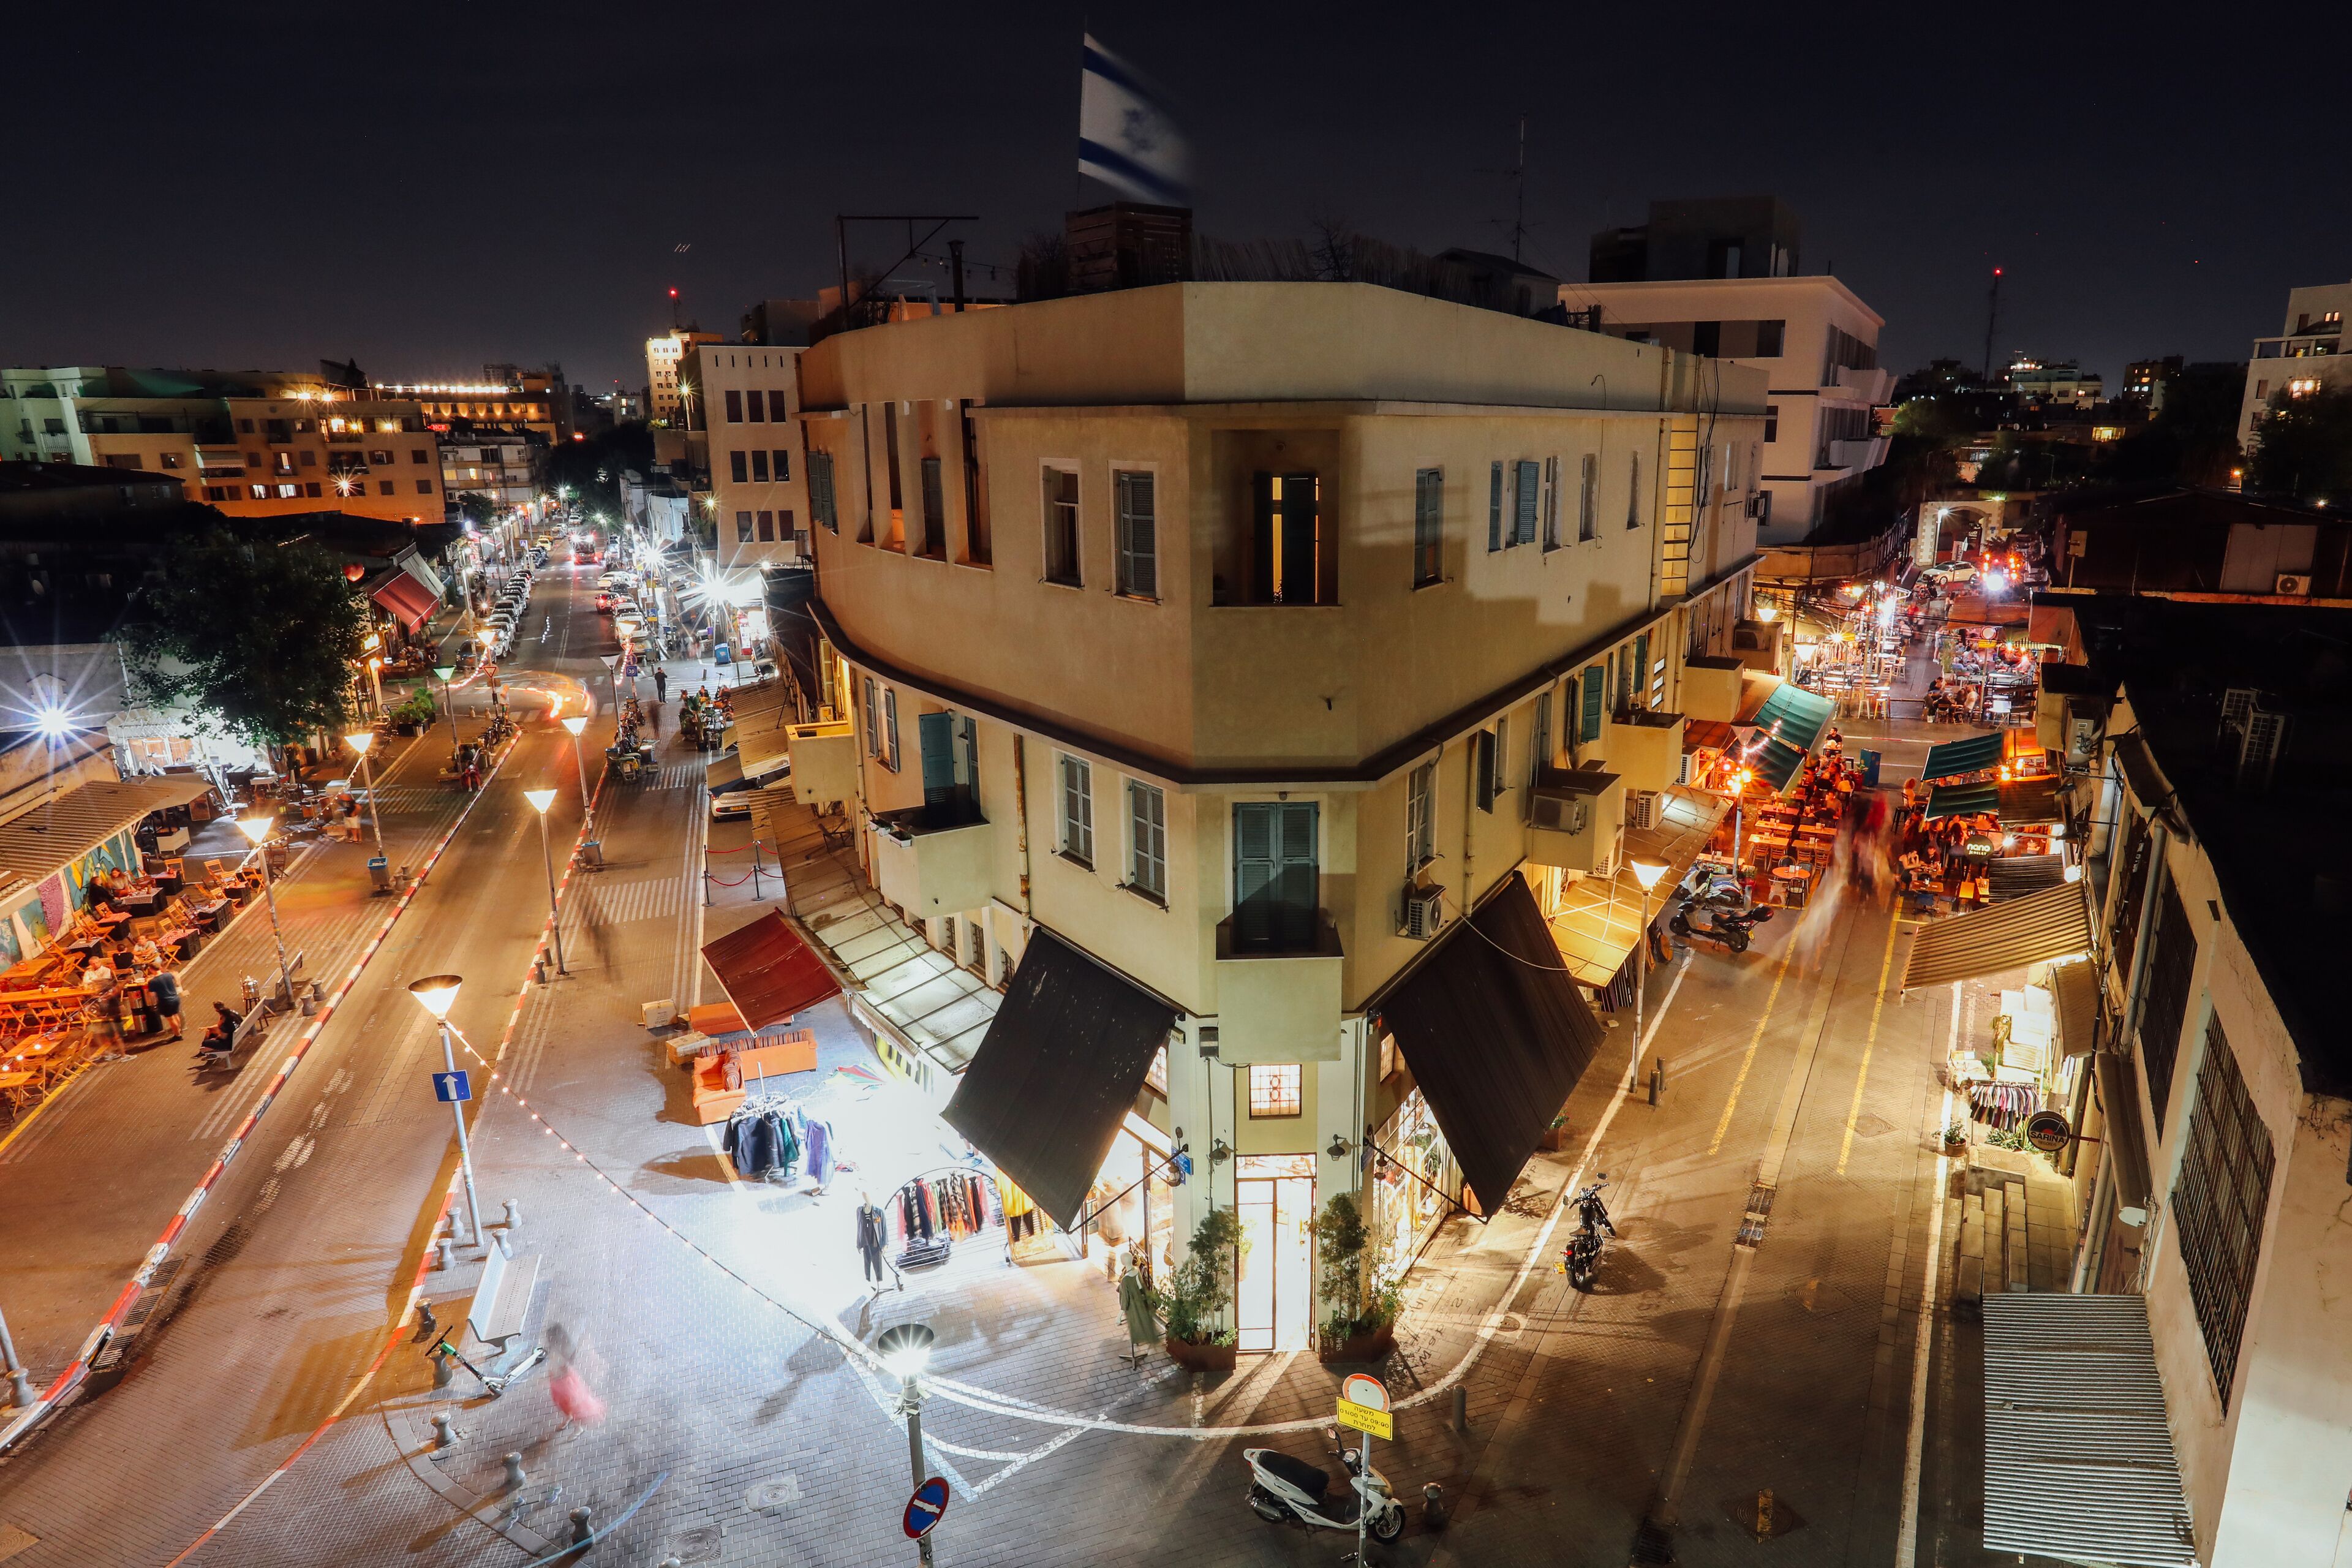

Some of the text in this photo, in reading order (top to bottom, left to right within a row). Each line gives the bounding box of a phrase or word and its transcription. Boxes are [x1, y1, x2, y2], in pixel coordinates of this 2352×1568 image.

[1967, 843, 1991, 852] nano
[2030, 1131, 2065, 1144] SARINA
[1353, 1406, 1374, 1417] משעה
[1353, 1419, 1376, 1431] למחרת
